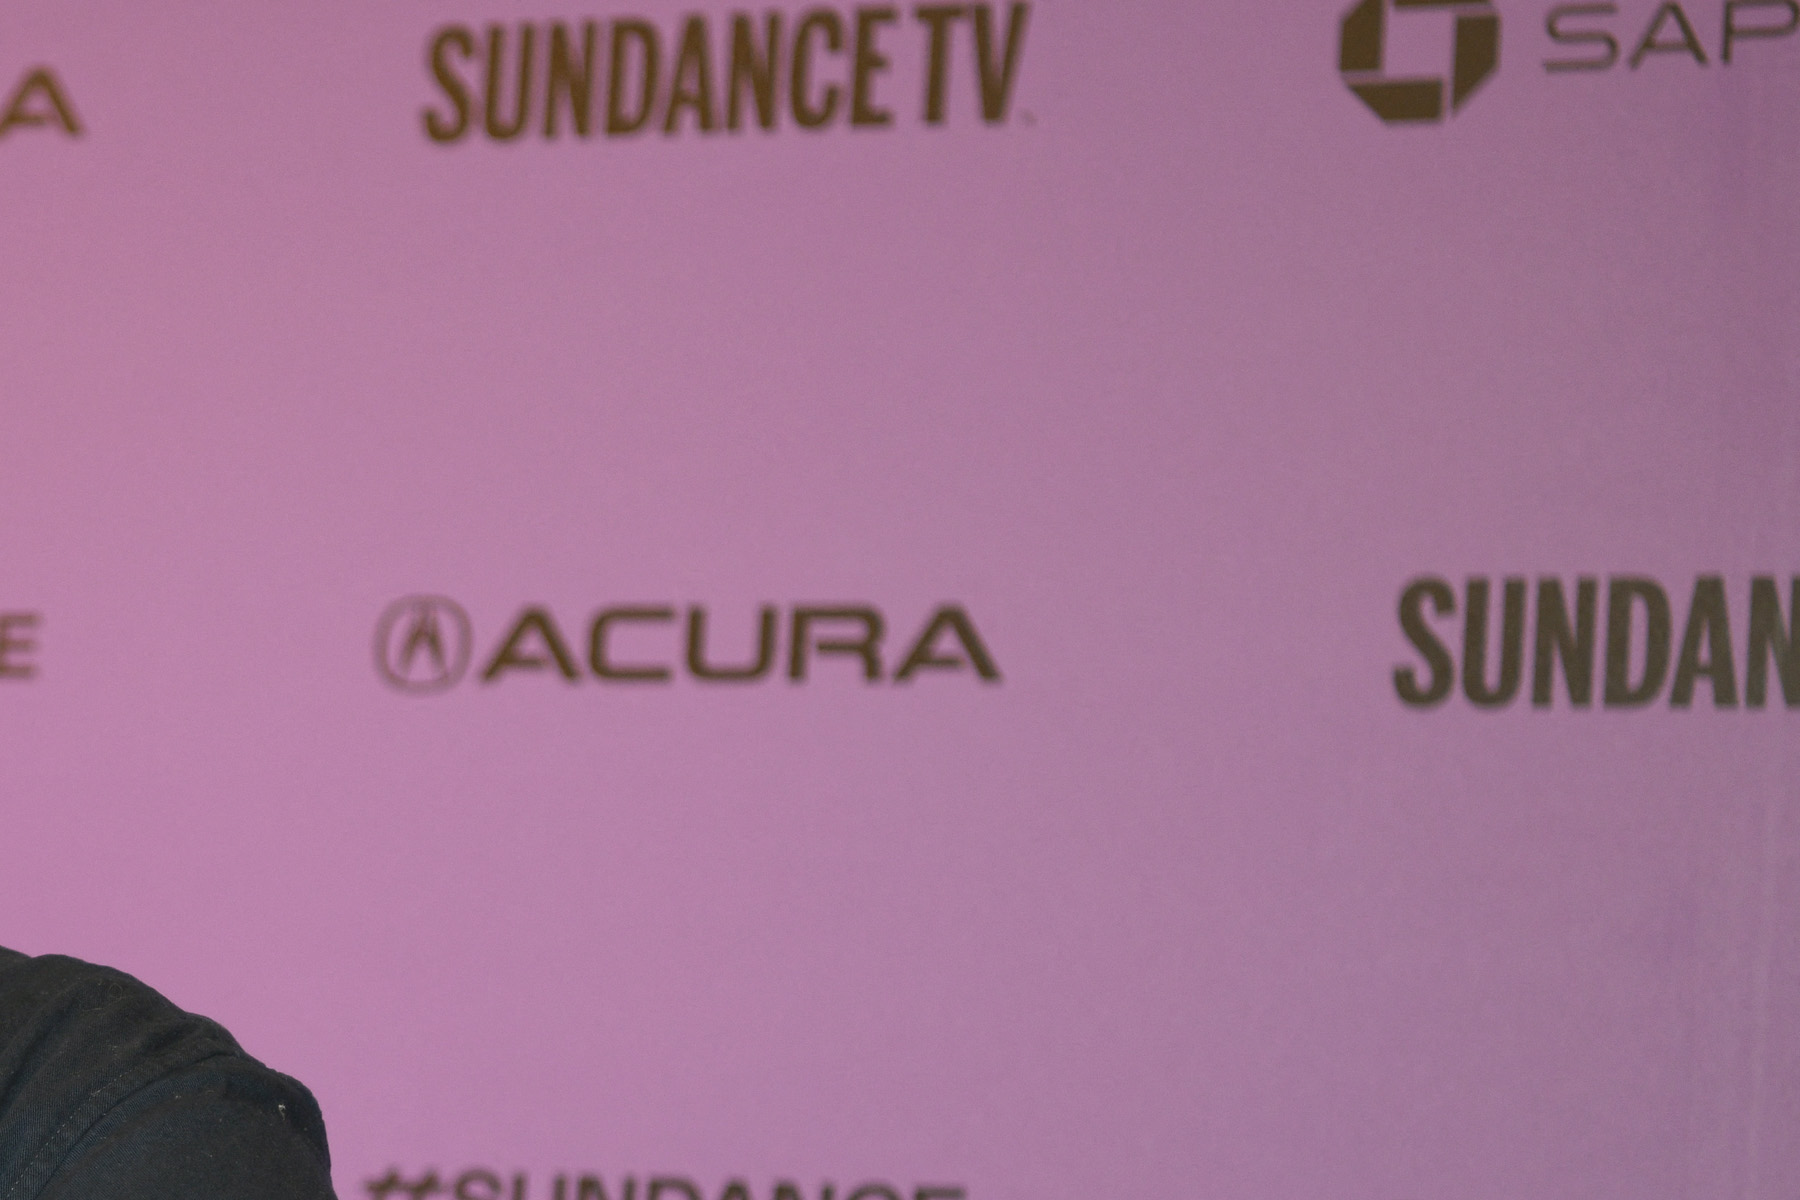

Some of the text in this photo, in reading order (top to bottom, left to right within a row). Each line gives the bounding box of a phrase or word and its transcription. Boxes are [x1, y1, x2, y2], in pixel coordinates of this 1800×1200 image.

[1543, 2, 1800, 71] SAP
[482, 604, 1001, 684] ACURA
[1393, 573, 1800, 712] SUNDAN
